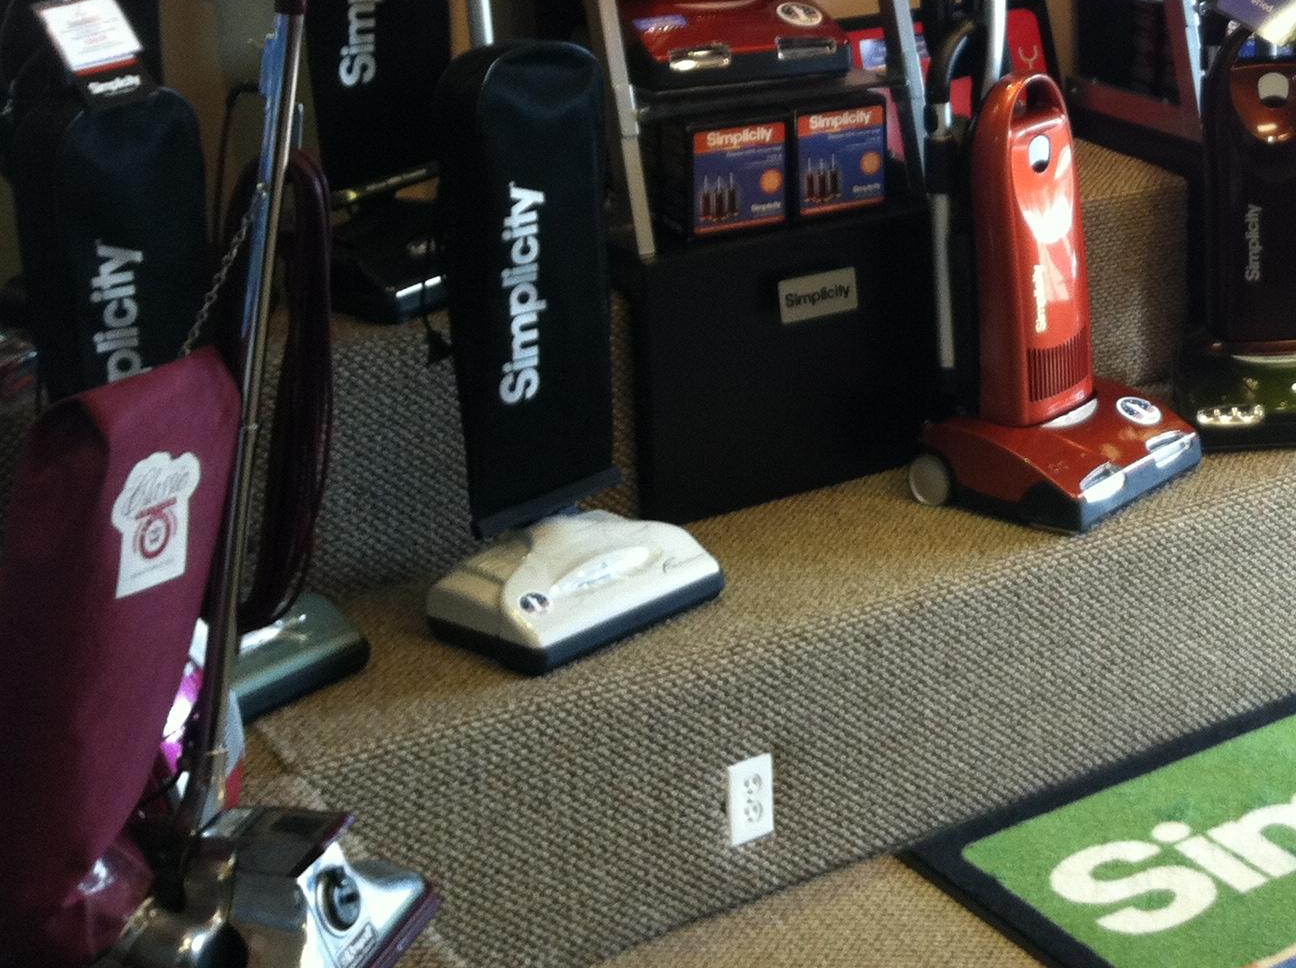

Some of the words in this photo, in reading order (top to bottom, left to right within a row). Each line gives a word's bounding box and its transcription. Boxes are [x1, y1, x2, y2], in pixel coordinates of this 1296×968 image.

[706, 126, 774, 148] Simplicity
[809, 109, 872, 130] Simplicity
[1244, 203, 1263, 281] Simplicity
[90, 244, 153, 383] plicity
[499, 184, 548, 405] Simplicity
[785, 284, 850, 308] Simplicity
[1032, 264, 1048, 334] Simplicity
